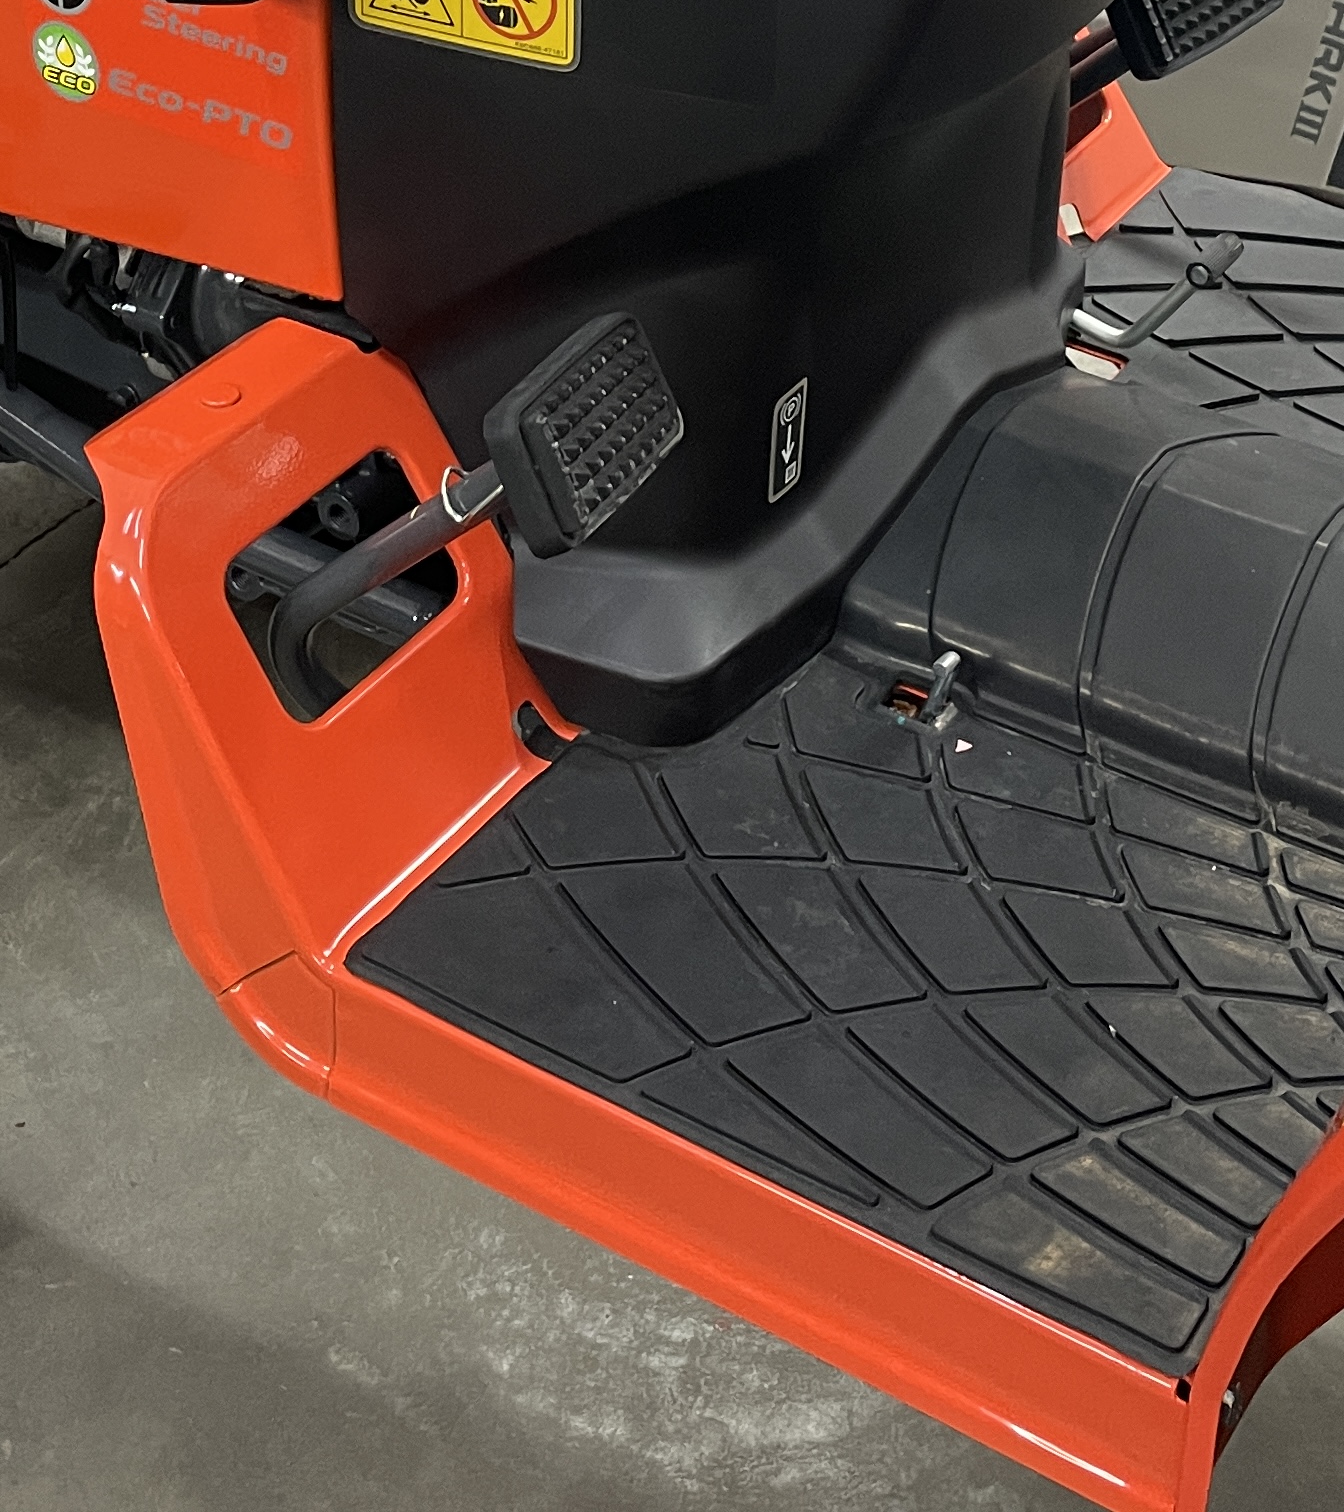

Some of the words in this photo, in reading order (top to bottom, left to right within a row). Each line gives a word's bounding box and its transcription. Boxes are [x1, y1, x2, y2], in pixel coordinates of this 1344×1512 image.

[140, 3, 289, 77] Steering
[42, 64, 97, 96] ECO
[107, 67, 294, 151] Eco-PTO
